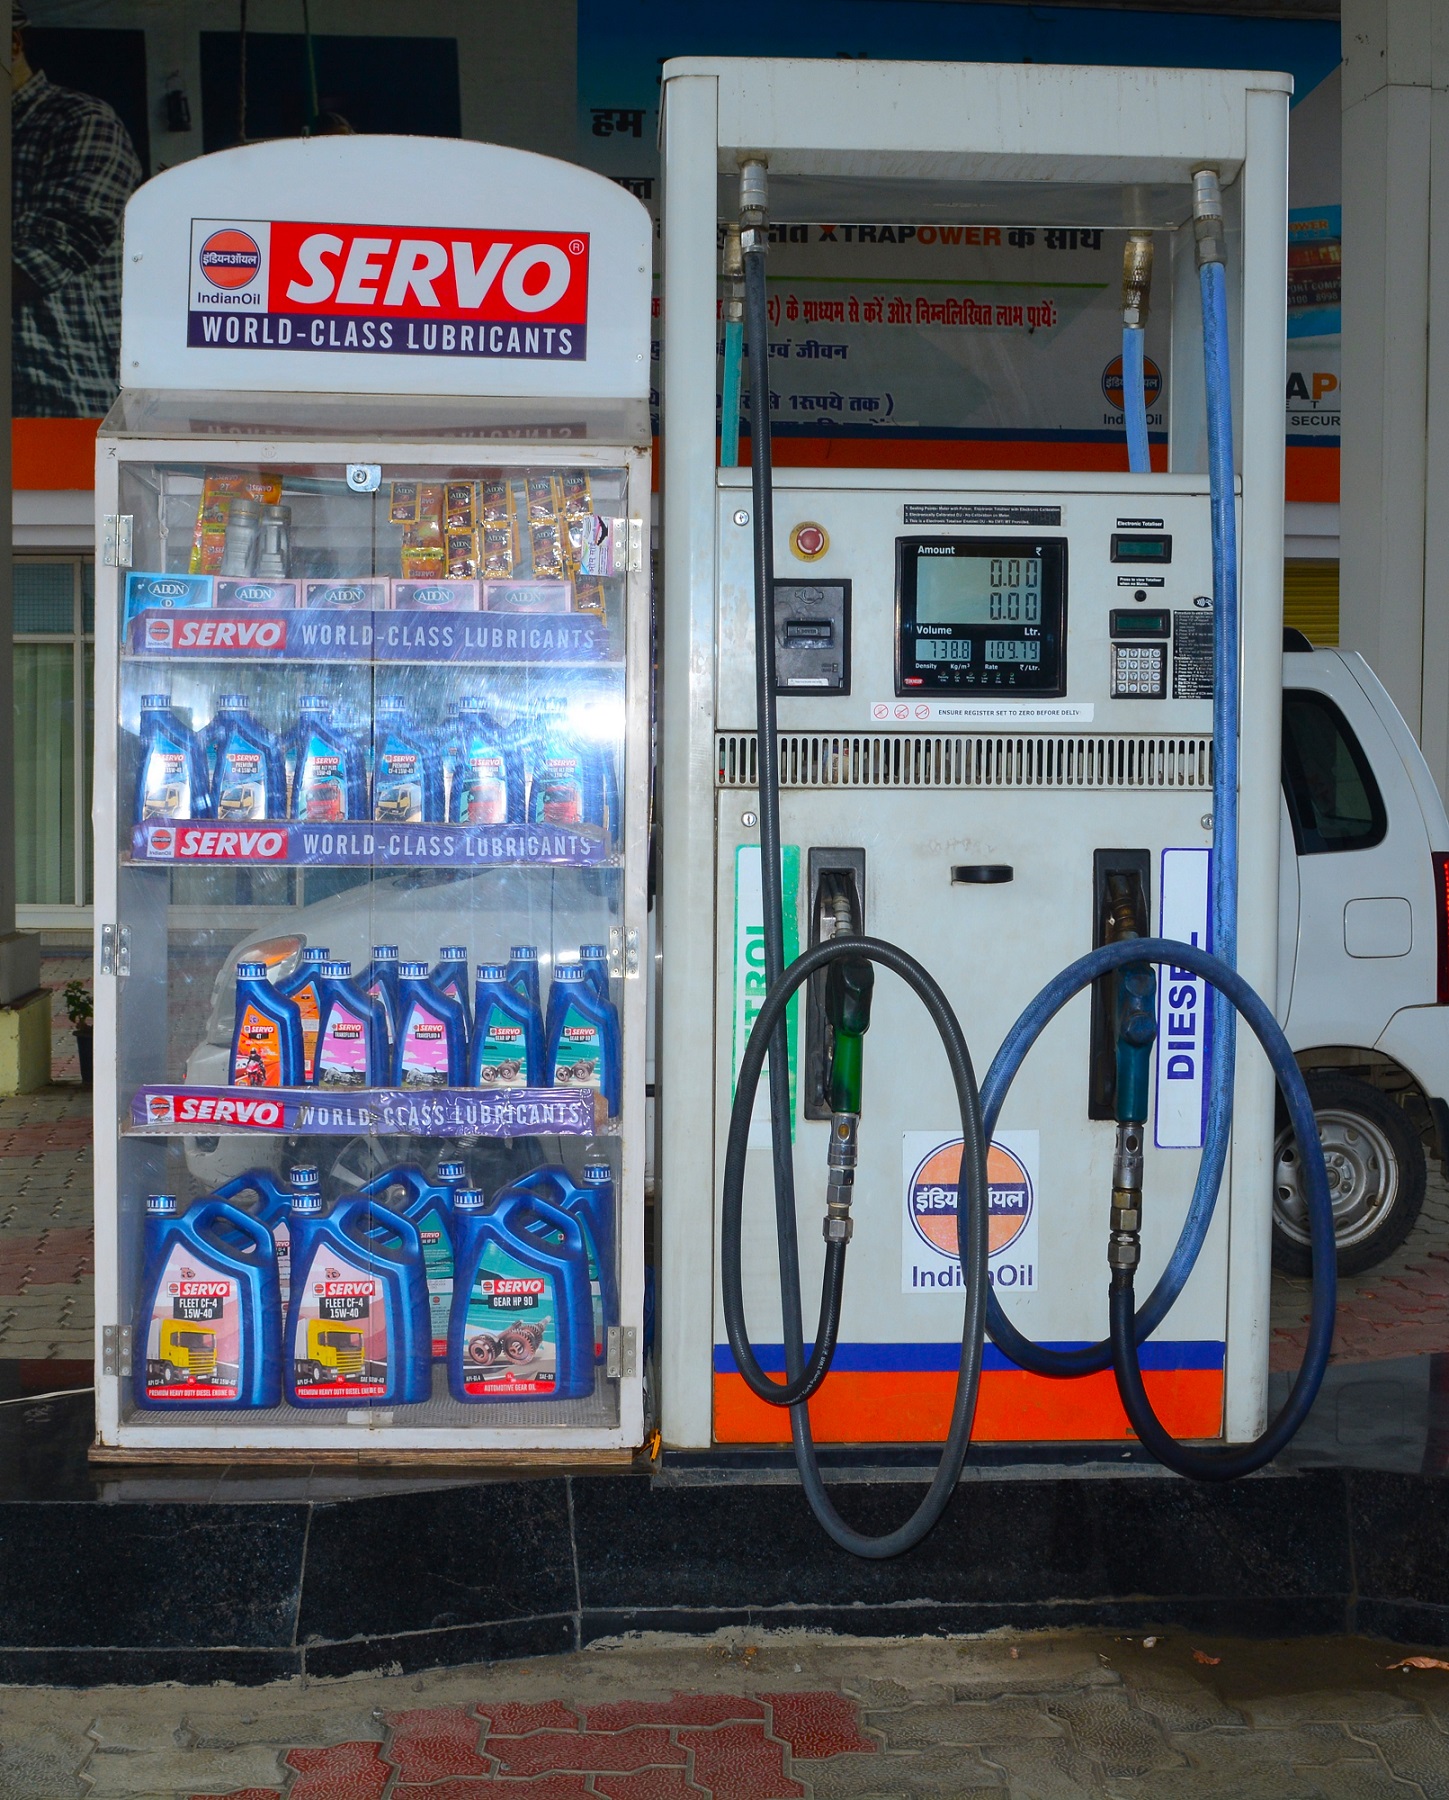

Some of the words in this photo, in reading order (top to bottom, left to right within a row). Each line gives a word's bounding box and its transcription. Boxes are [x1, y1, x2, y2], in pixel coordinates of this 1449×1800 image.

[590, 108, 646, 138] हम
[819, 225, 1001, 246] XTRAPOWER
[203, 252, 257, 266] इंडियनऑयल
[285, 233, 572, 313] SERVO
[198, 292, 260, 304] IndianOil
[786, 295, 799, 321] के
[803, 301, 844, 323] माध्यम
[849, 296, 860, 322] से
[864, 297, 884, 323] करें
[887, 298, 911, 325] और
[915, 297, 992, 326] निम्नलिखित
[996, 304, 1023, 326] लाभ
[202, 315, 392, 350] WORLD-CLASS
[407, 322, 572, 355] LUBRICANTS
[796, 340, 849, 360] जीवन
[849, 395, 881, 411] तक
[1104, 413, 1162, 425] IndOil
[917, 545, 955, 554] Amount
[990, 559, 1038, 588] 0.00
[152, 584, 187, 595] ADON
[237, 589, 273, 599] ADON
[328, 590, 362, 601] ADON
[418, 590, 450, 601] ADON
[510, 591, 542, 602] ADON
[989, 592, 1037, 621] 0.00
[178, 623, 280, 647] SERVO
[303, 625, 453, 647] WORLD-CLASS
[465, 626, 595, 649] LUBRICANTS
[916, 626, 952, 635] Volume
[1024, 627, 1041, 636] Ltr.
[930, 640, 970, 660] 738.8
[989, 641, 1038, 660] 109.79
[180, 832, 282, 857] SERVO
[303, 834, 454, 856] WORLD-CLASS
[466, 836, 591, 857] LUBRICANTS
[180, 1099, 279, 1125] SERVO
[455, 1103, 579, 1126] LUBRICANTS
[912, 1264, 1033, 1287] IndiOil
[182, 1283, 228, 1296] SERVO
[327, 1282, 373, 1296] SERVO
[496, 1280, 542, 1293] SERVO
[179, 1298, 199, 1308] FLEET
[201, 1298, 217, 1308] CF-4
[325, 1298, 345, 1308] FLEET
[346, 1297, 363, 1307] CF-4
[493, 1297, 511, 1306] GEAR
[512, 1297, 522, 1306] HP
[523, 1297, 533, 1306] 90
[183, 1308, 212, 1318] 15W-40
[330, 1307, 359, 1318] 15W-40
[169, 1389, 183, 1397] HEAVY
[484, 1384, 514, 1392] AUTOMOTIVE
